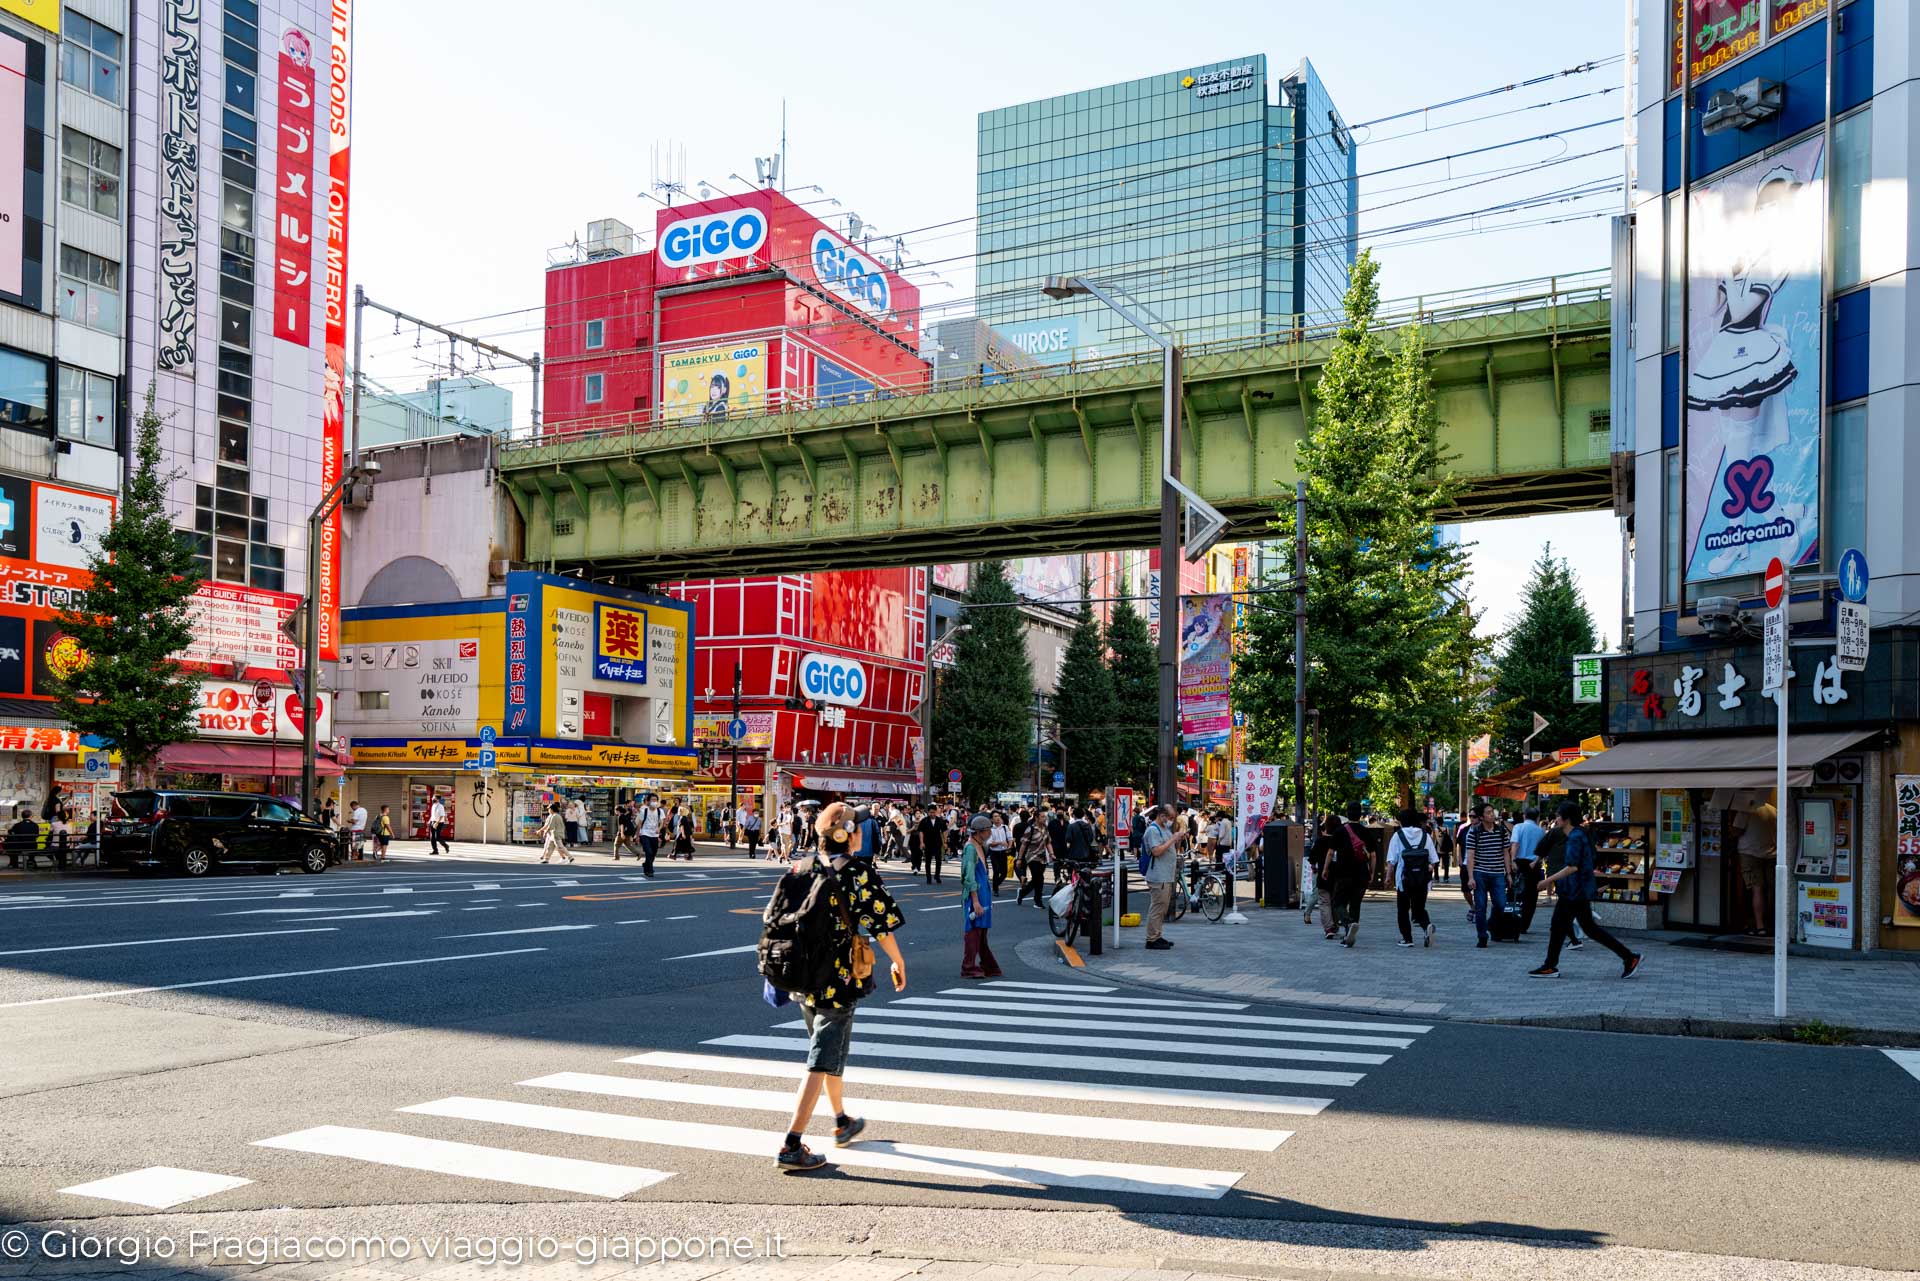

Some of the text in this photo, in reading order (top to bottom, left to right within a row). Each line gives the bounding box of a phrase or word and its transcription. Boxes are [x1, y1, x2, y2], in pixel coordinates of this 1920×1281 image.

[1197, 64, 1253, 85] 住友不動産
[330, 45, 346, 137] GOODS
[1196, 77, 1253, 98] 秋葉原ビル
[280, 76, 311, 331] ラブメルシー
[328, 177, 345, 239] LOVE
[664, 214, 762, 262] GiGO
[815, 238, 887, 312] GiGO
[326, 246, 342, 327] MERCI
[1012, 327, 1069, 354] HIROSE
[733, 348, 758, 360] GiGO
[1707, 521, 1793, 548] maidreamin
[213, 590, 237, 601] GUIDE
[548, 609, 590, 624] SHISEIDO
[605, 610, 640, 656] 薬
[650, 626, 684, 639] SHISEIDO
[552, 638, 585, 651] Kanebo
[554, 652, 583, 664] SOFINA
[652, 653, 680, 664] Kanebo
[417, 673, 469, 684] SHISEIDO
[654, 666, 679, 676] SOFINA
[805, 661, 863, 699] GiGO
[436, 688, 463, 699] KOSÉ
[421, 704, 461, 717] Kanebo
[421, 721, 457, 733] SOFINA
[483, 751, 492, 766] P
